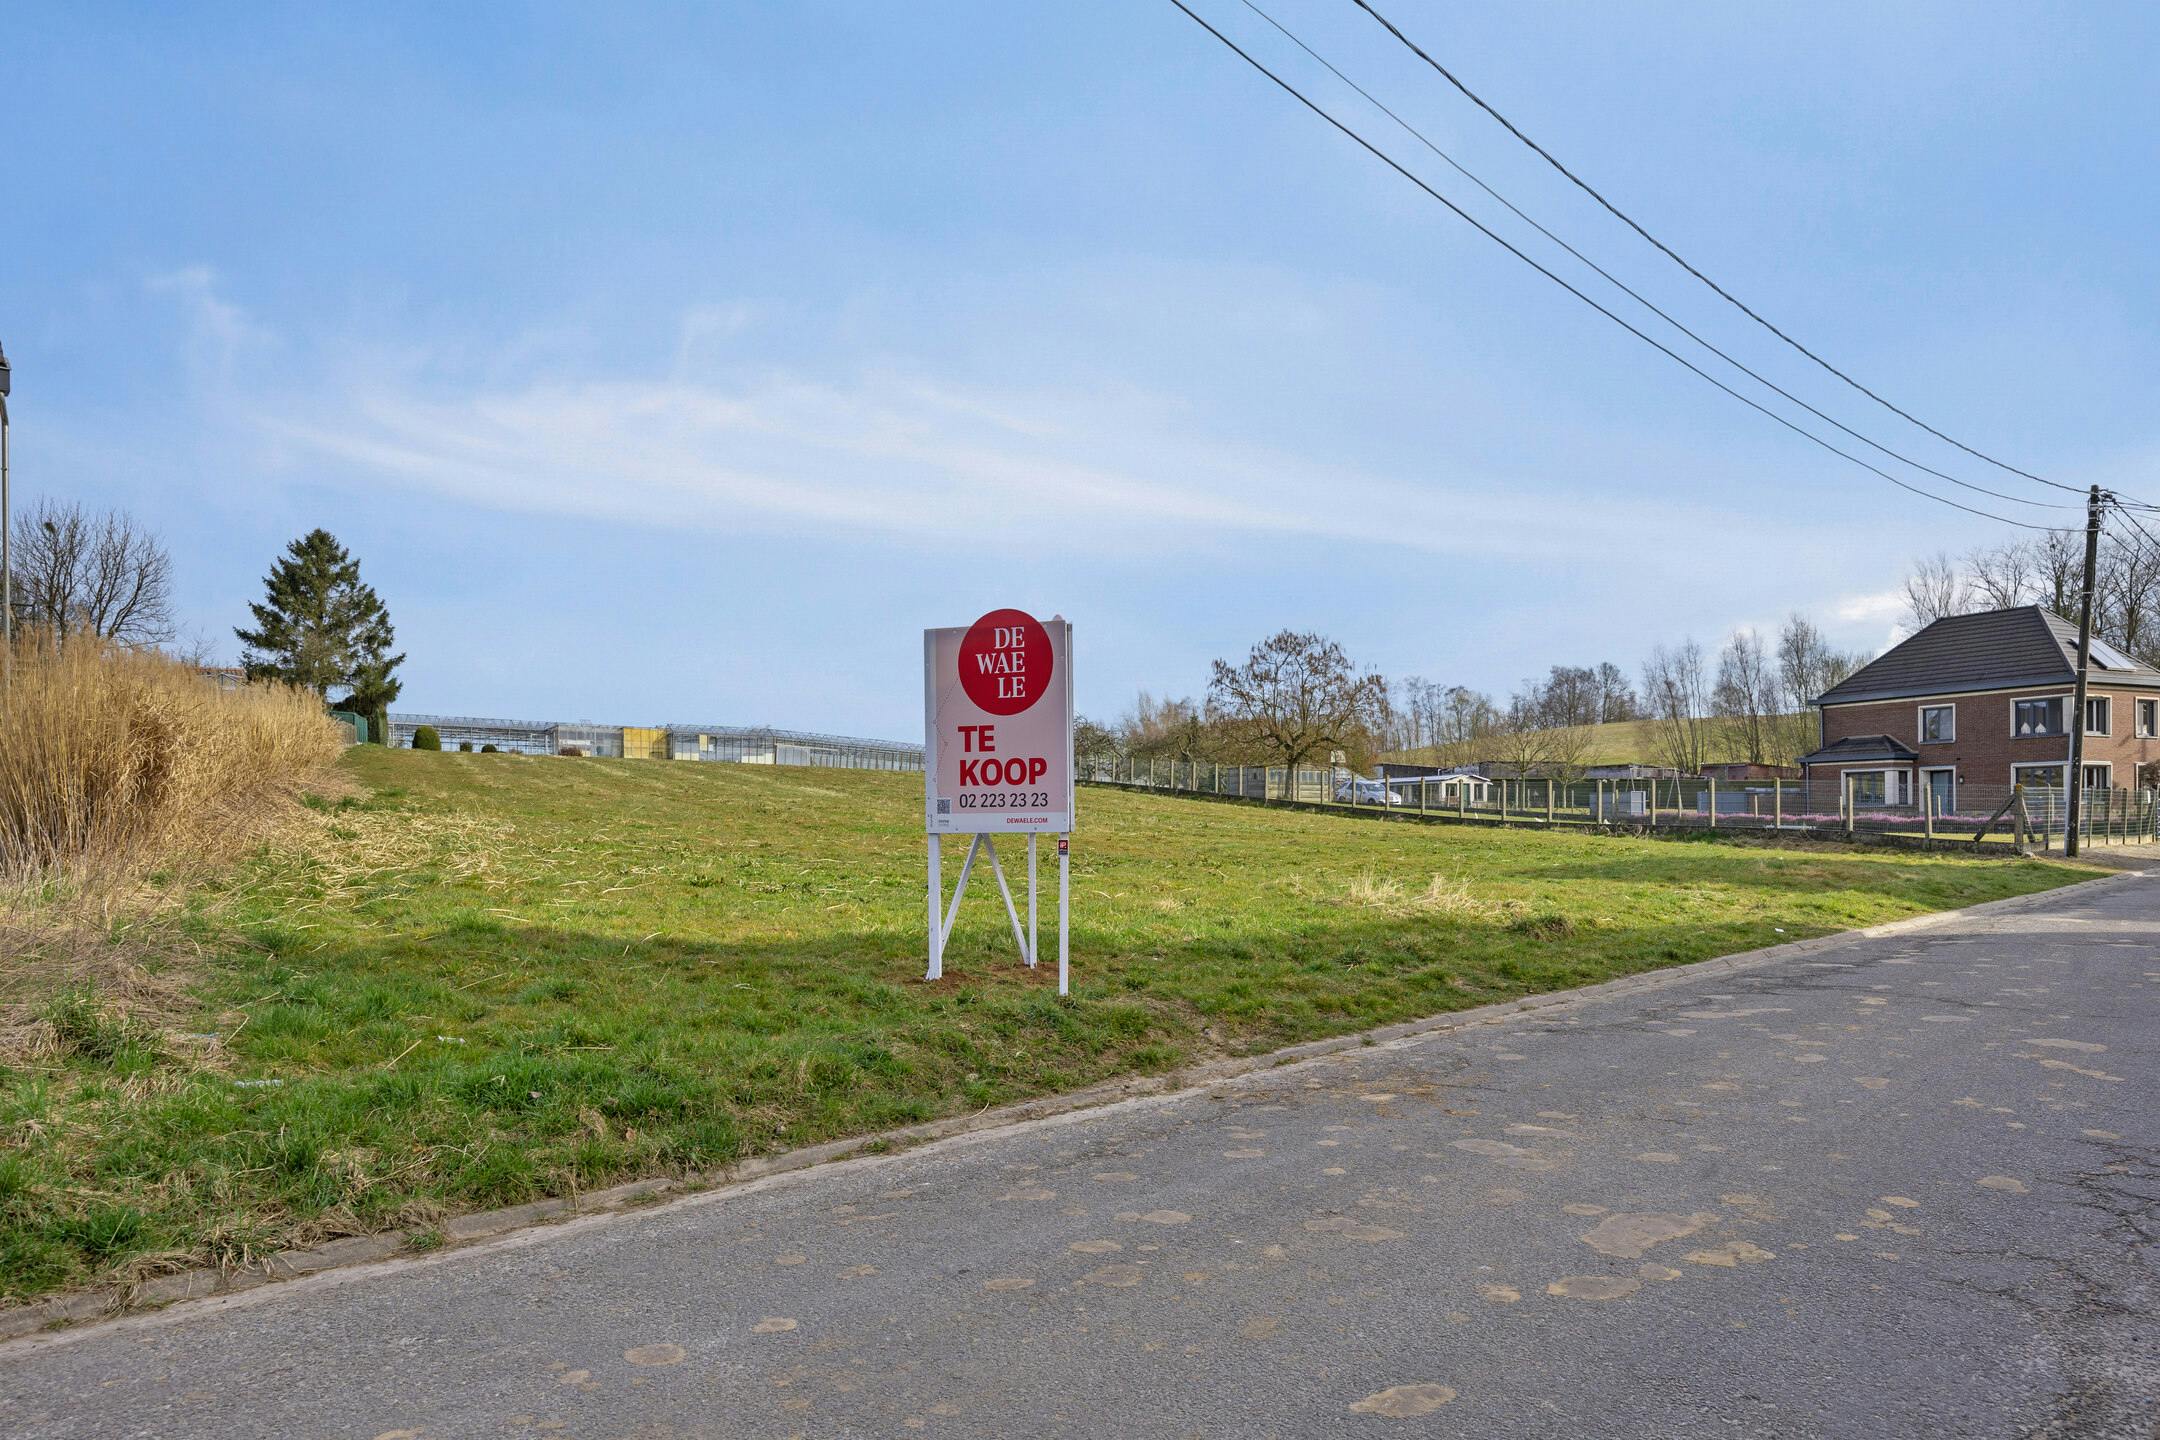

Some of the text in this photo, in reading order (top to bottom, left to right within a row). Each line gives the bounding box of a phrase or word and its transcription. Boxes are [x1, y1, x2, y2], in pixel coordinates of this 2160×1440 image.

[994, 626, 1025, 650] DE
[975, 651, 1025, 675] WAE
[998, 676, 1026, 699] LE
[957, 724, 996, 753] TE
[959, 757, 1048, 787] KOOP
[959, 792, 1049, 808] 02 223 23 23
